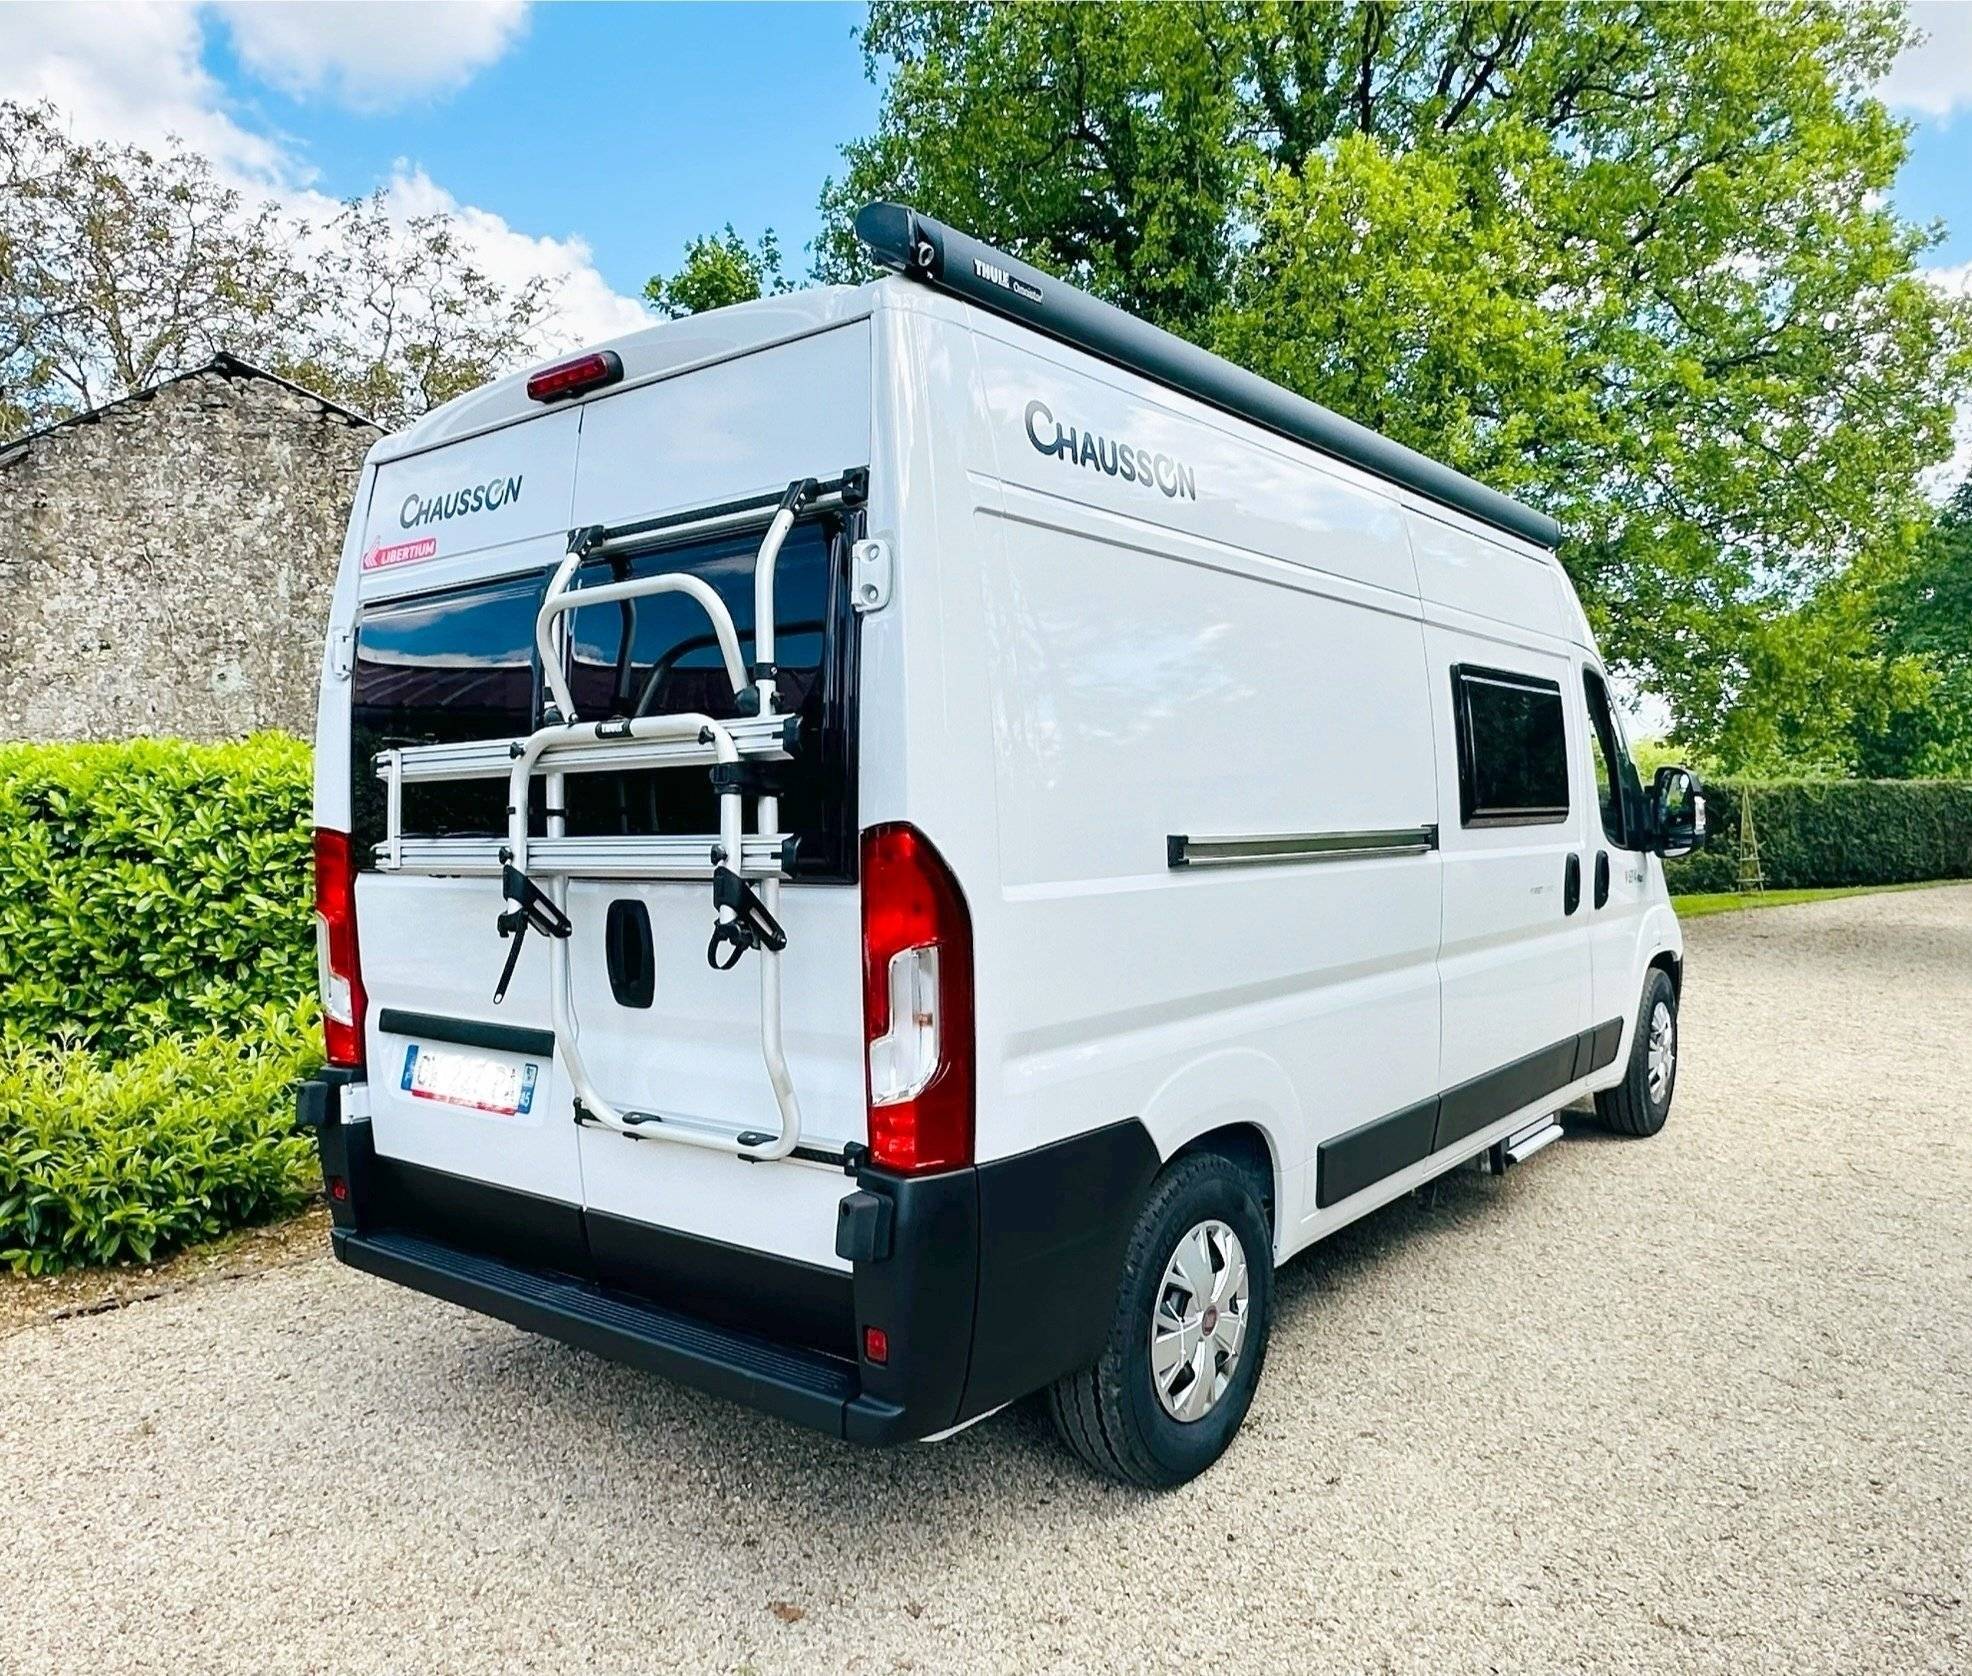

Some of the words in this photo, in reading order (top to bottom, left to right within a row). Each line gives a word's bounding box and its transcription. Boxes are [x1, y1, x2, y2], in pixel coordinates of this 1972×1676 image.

[974, 258, 1010, 288] THULE
[1025, 400, 1196, 501] CHAUSSON
[400, 475, 522, 528] CHAUSSON
[382, 541, 435, 564] LIBERTIUM
